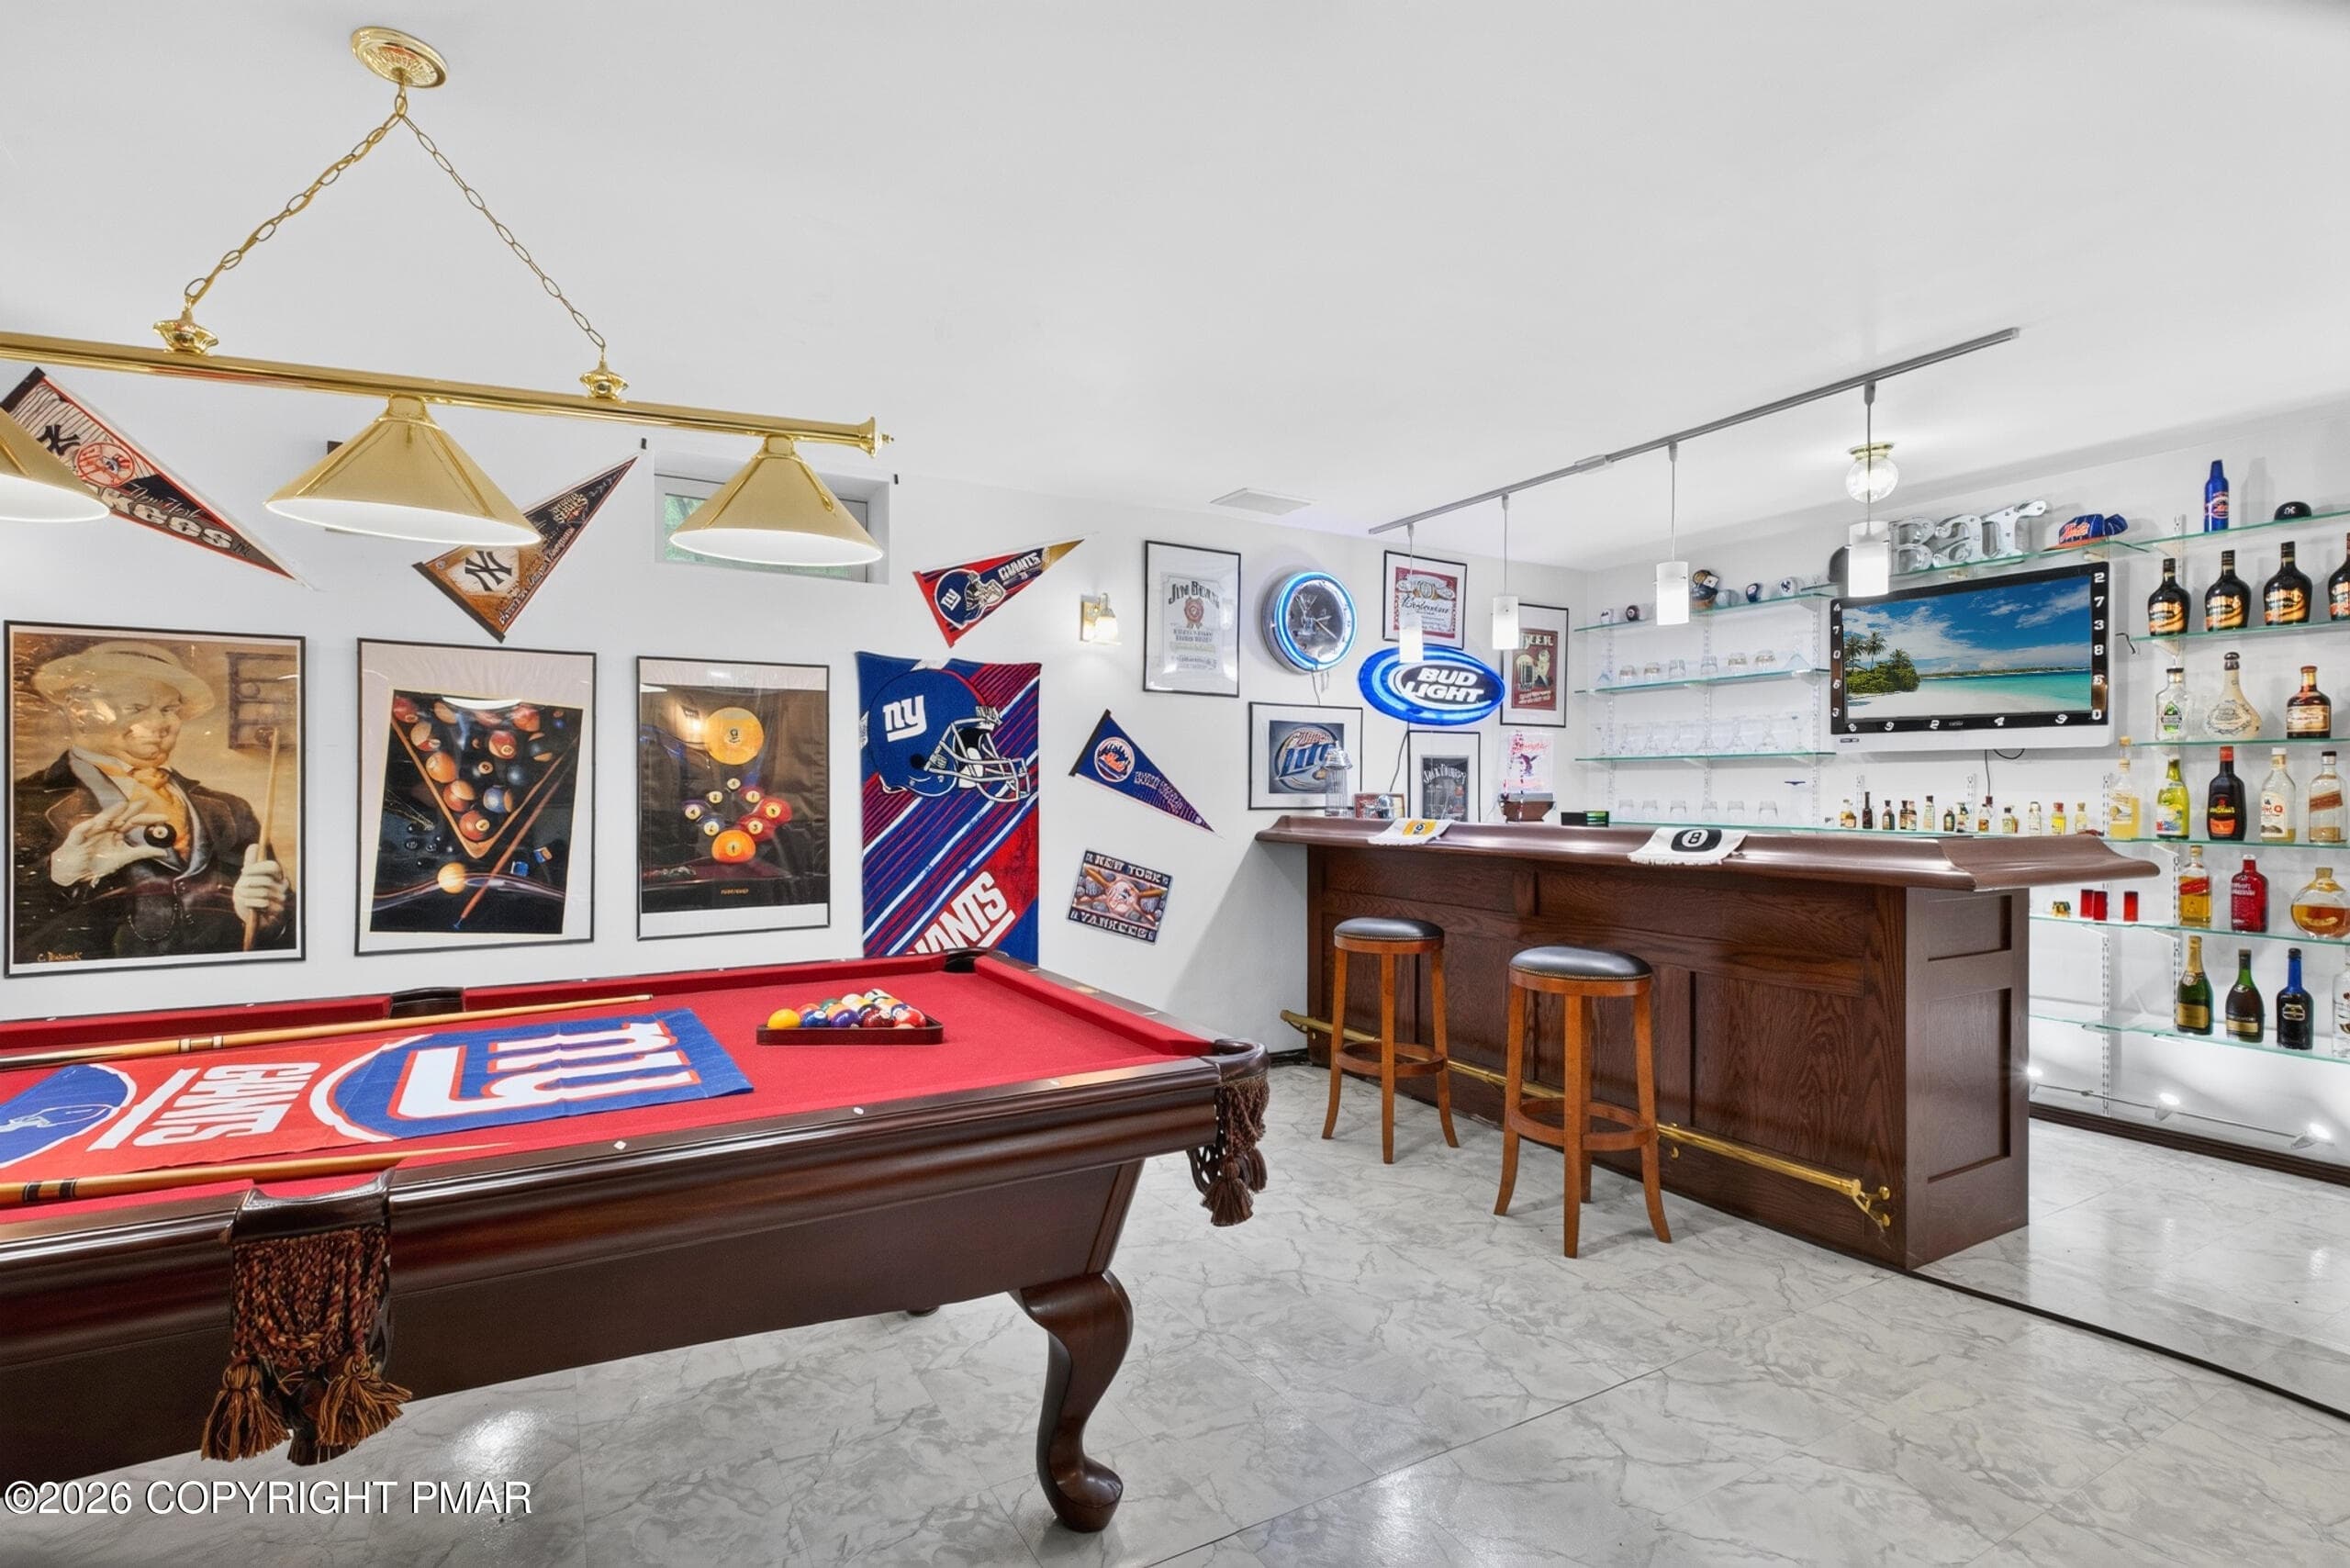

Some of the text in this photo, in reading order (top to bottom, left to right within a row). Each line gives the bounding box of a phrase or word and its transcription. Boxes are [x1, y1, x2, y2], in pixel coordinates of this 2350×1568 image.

[1888, 499, 2047, 574] Bar
[2094, 596, 2104, 607] 7
[2094, 620, 2104, 630] 3
[2094, 644, 2103, 655] 8
[1417, 667, 1477, 687] BUD
[1404, 681, 1484, 702] LIGHT
[1688, 831, 1702, 845] 8
[132, 1062, 321, 1147] GIANTS
